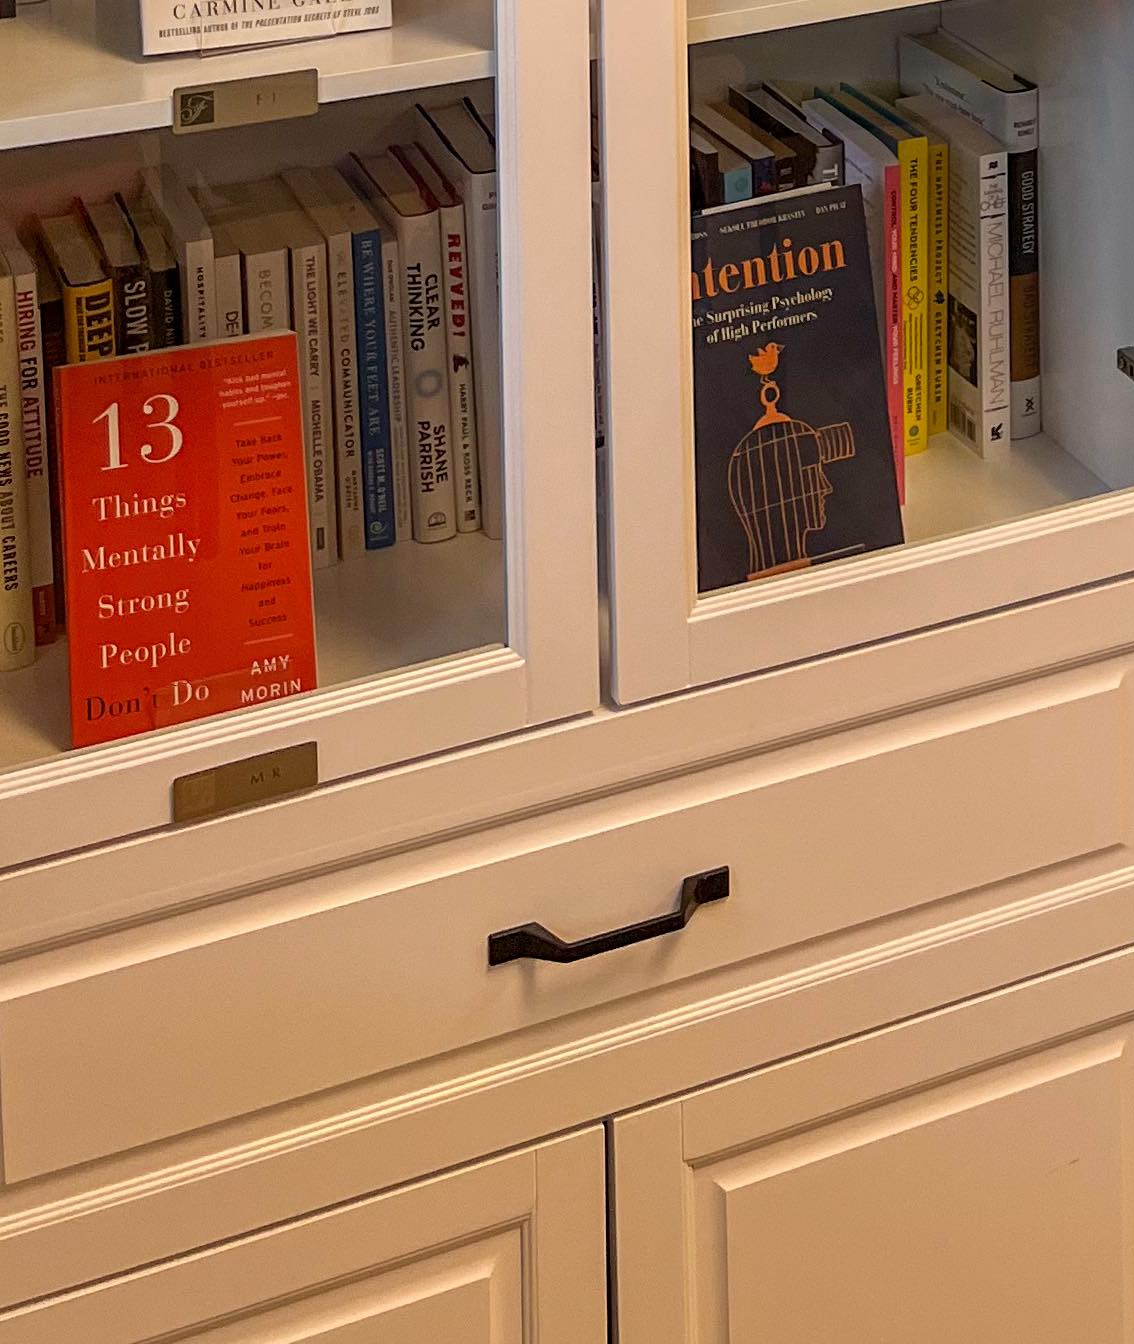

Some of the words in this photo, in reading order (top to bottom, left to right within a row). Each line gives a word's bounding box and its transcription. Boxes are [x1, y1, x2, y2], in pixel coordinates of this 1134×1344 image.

[407, 263, 426, 352] THINKING
[425, 274, 441, 330] CLEAR
[92, 394, 183, 471] 13
[433, 424, 448, 483] SHANE
[417, 421, 434, 493] PARRISH
[92, 489, 187, 522] Things
[82, 533, 201, 574] Mentally
[98, 588, 190, 619] Strong
[100, 636, 192, 668] People
[251, 654, 290, 676] AMY
[85, 687, 158, 722] Don't
[172, 679, 210, 706] Do
[241, 679, 301, 703] MORIN
